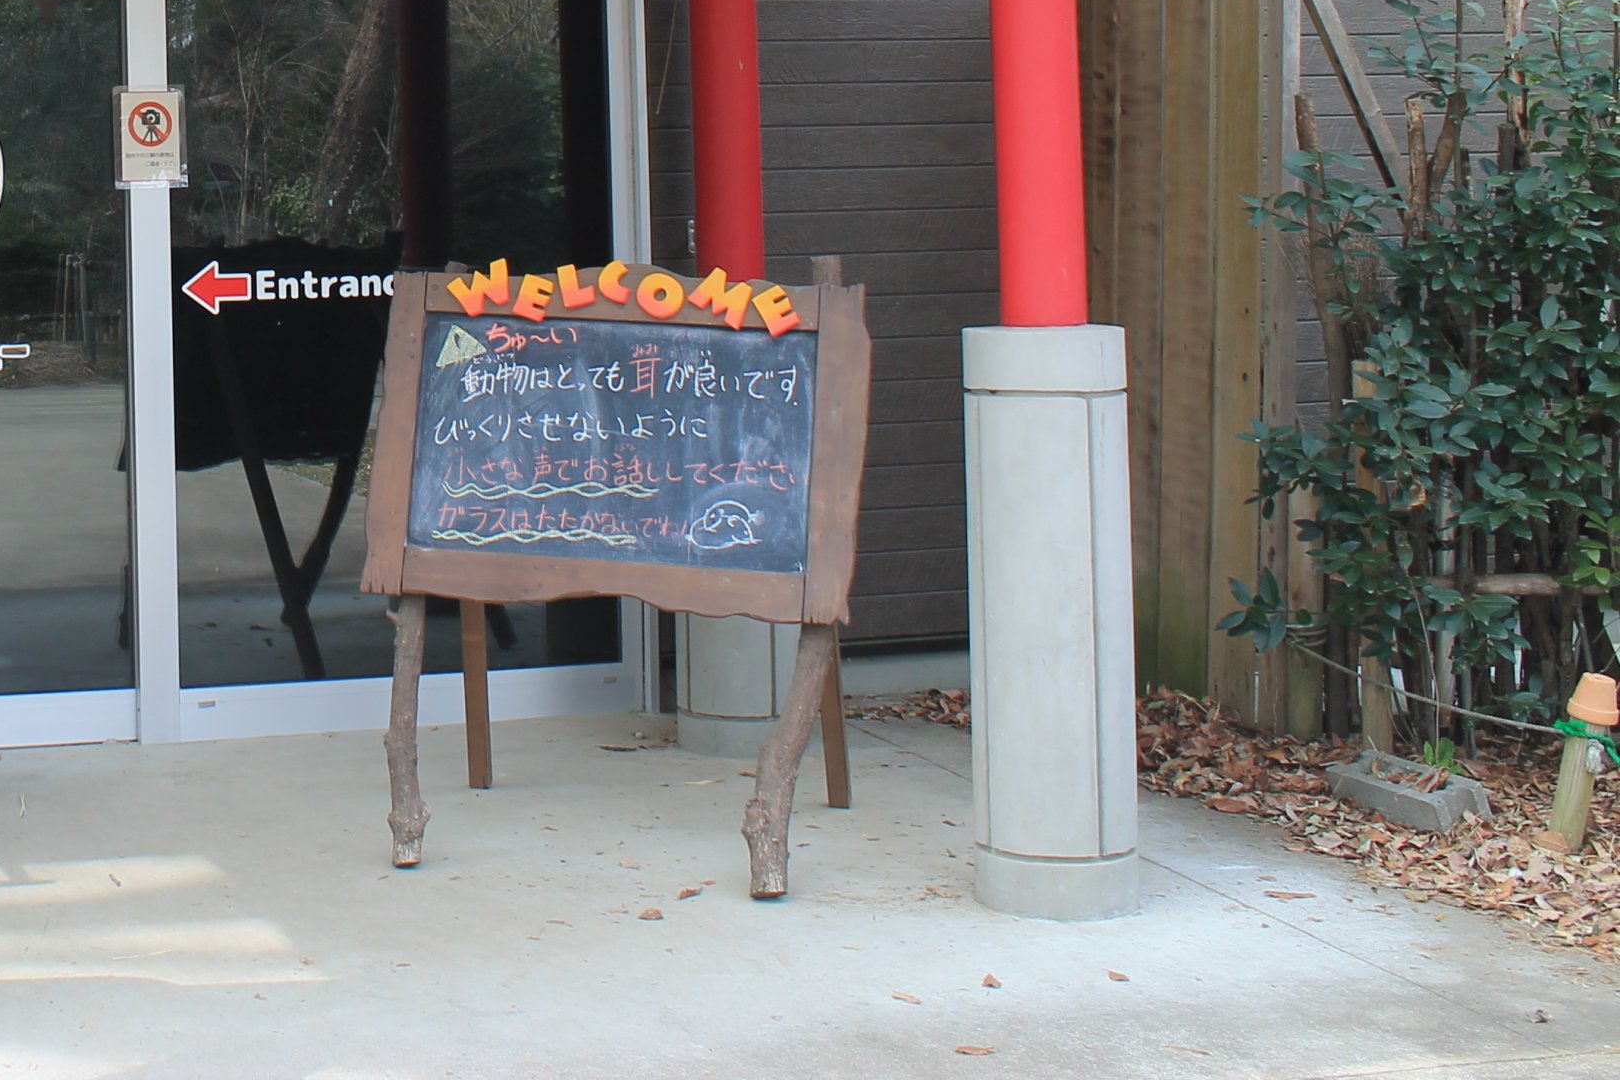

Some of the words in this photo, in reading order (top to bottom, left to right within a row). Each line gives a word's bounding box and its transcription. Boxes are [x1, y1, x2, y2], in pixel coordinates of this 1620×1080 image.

[446, 257, 801, 337] WELCOME
[434, 409, 708, 445] びっくりさせないように
